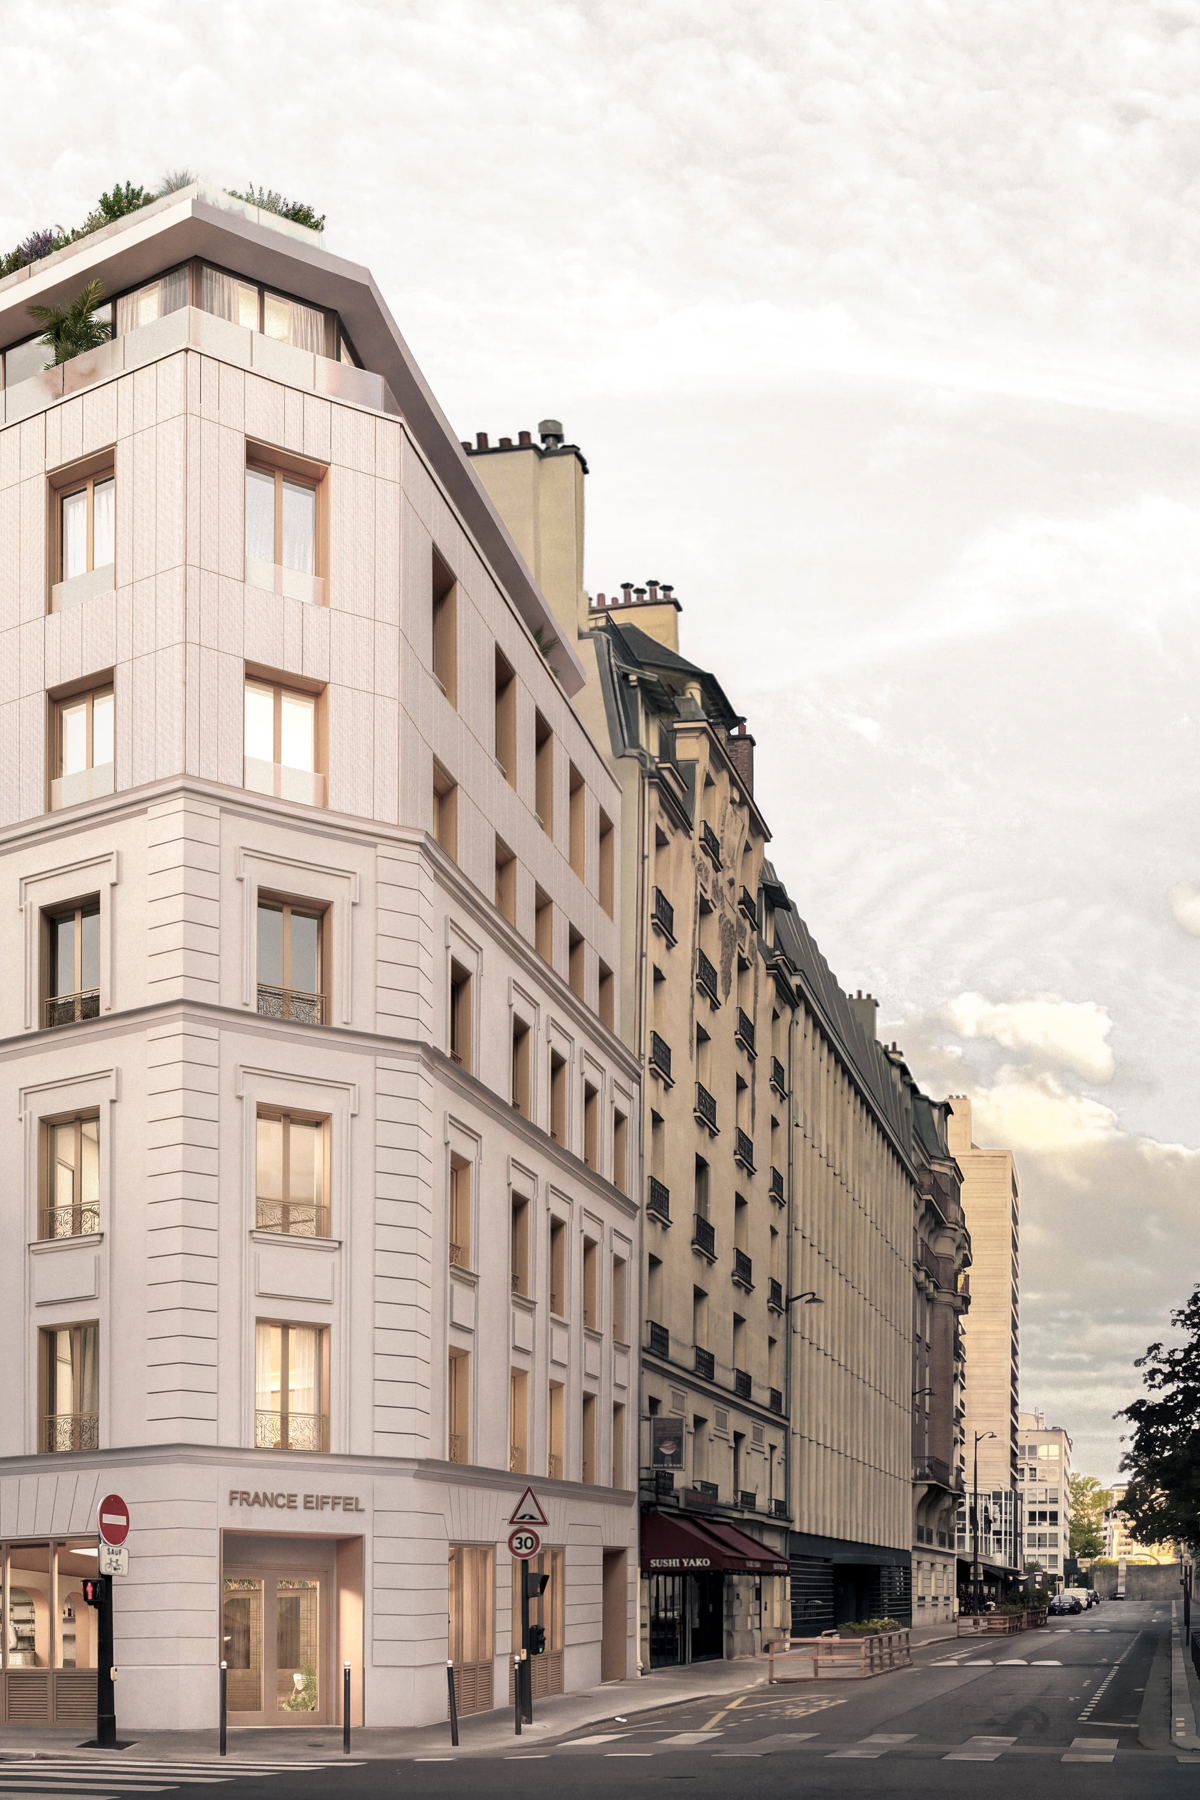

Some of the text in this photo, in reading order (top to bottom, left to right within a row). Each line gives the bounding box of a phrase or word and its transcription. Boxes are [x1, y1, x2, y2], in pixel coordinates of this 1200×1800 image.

[229, 1490, 365, 1512] FRANCE EIFFEL
[514, 1536, 535, 1550] 30
[107, 1547, 122, 1556] SAUF
[650, 1558, 711, 1567] SUSHI YAKO
